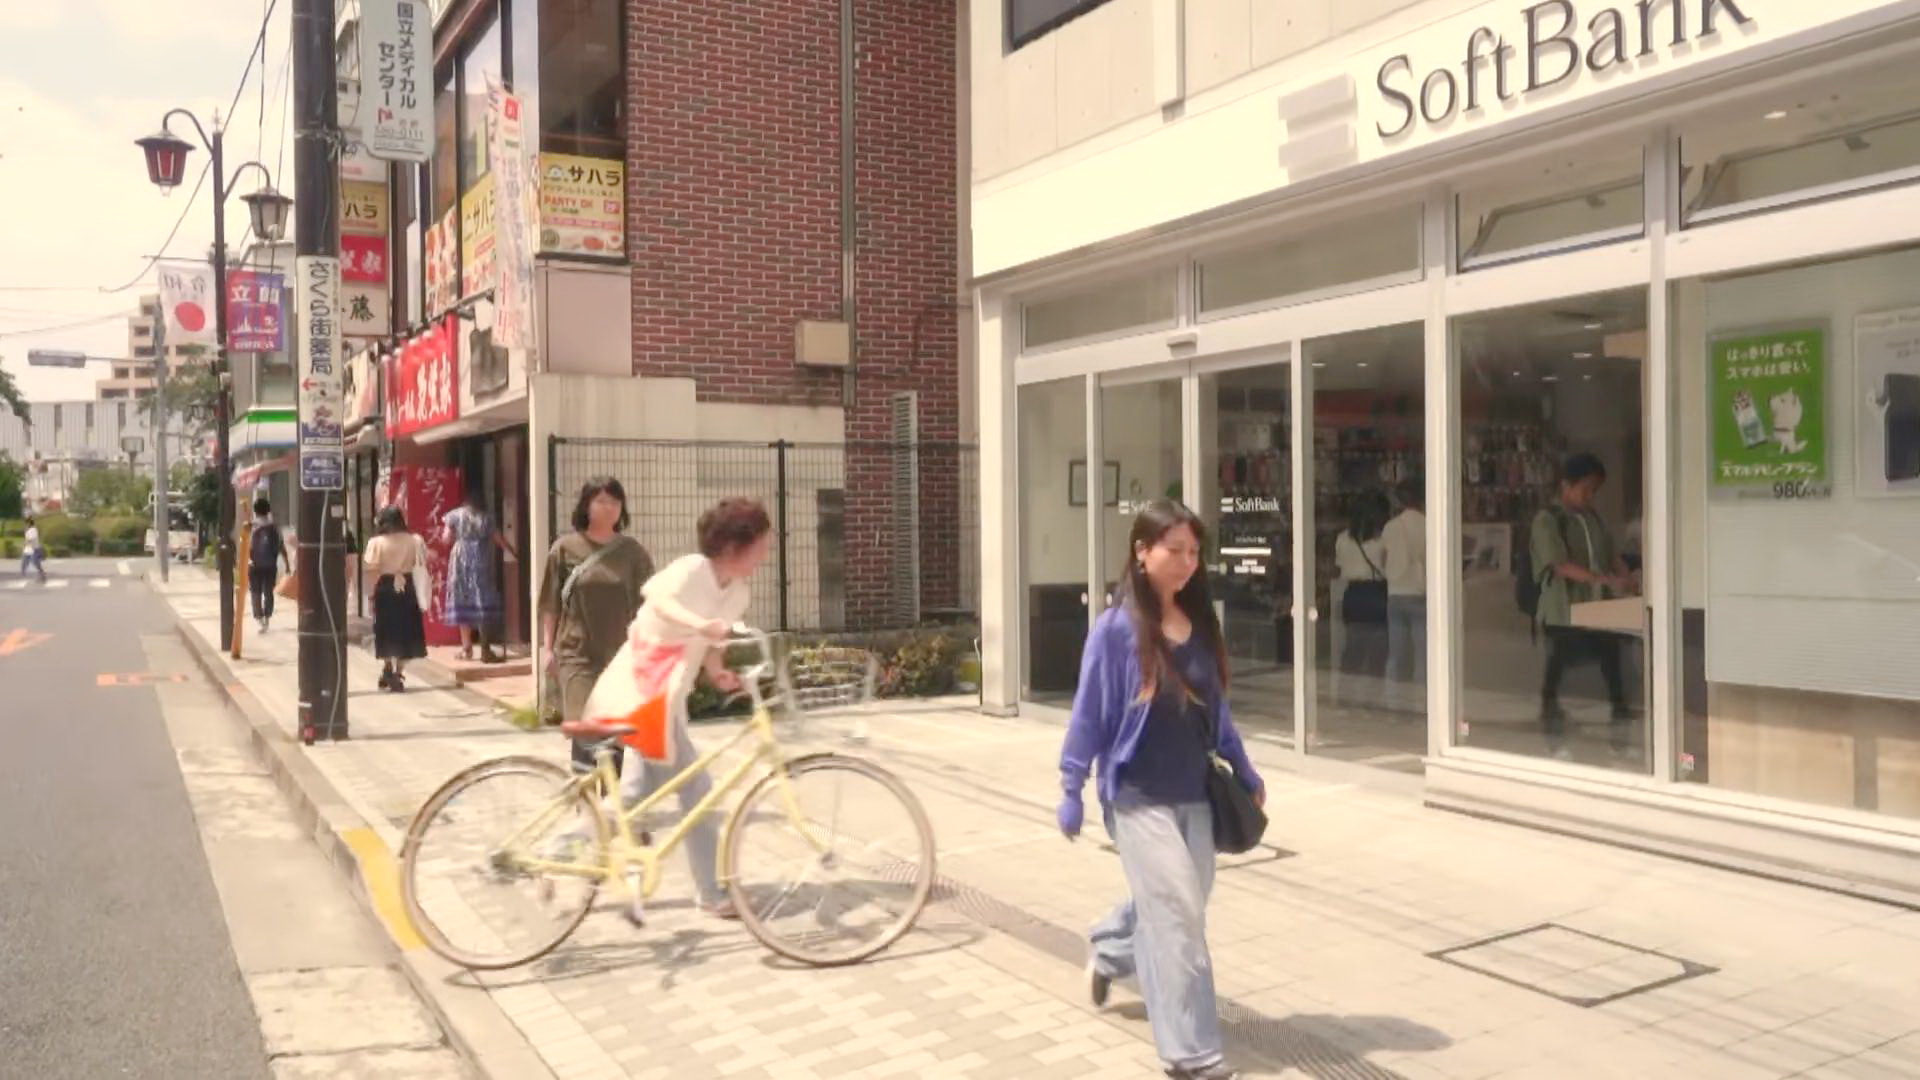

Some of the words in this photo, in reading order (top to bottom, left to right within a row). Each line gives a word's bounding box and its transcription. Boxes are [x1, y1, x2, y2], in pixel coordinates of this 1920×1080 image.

[378, 41, 395, 107] センター
[397, 2, 417, 110] 国立メディカル
[1375, 0, 1755, 139] SoftBank
[568, 165, 620, 186] サハラ
[1235, 497, 1280, 512] SoftBank
